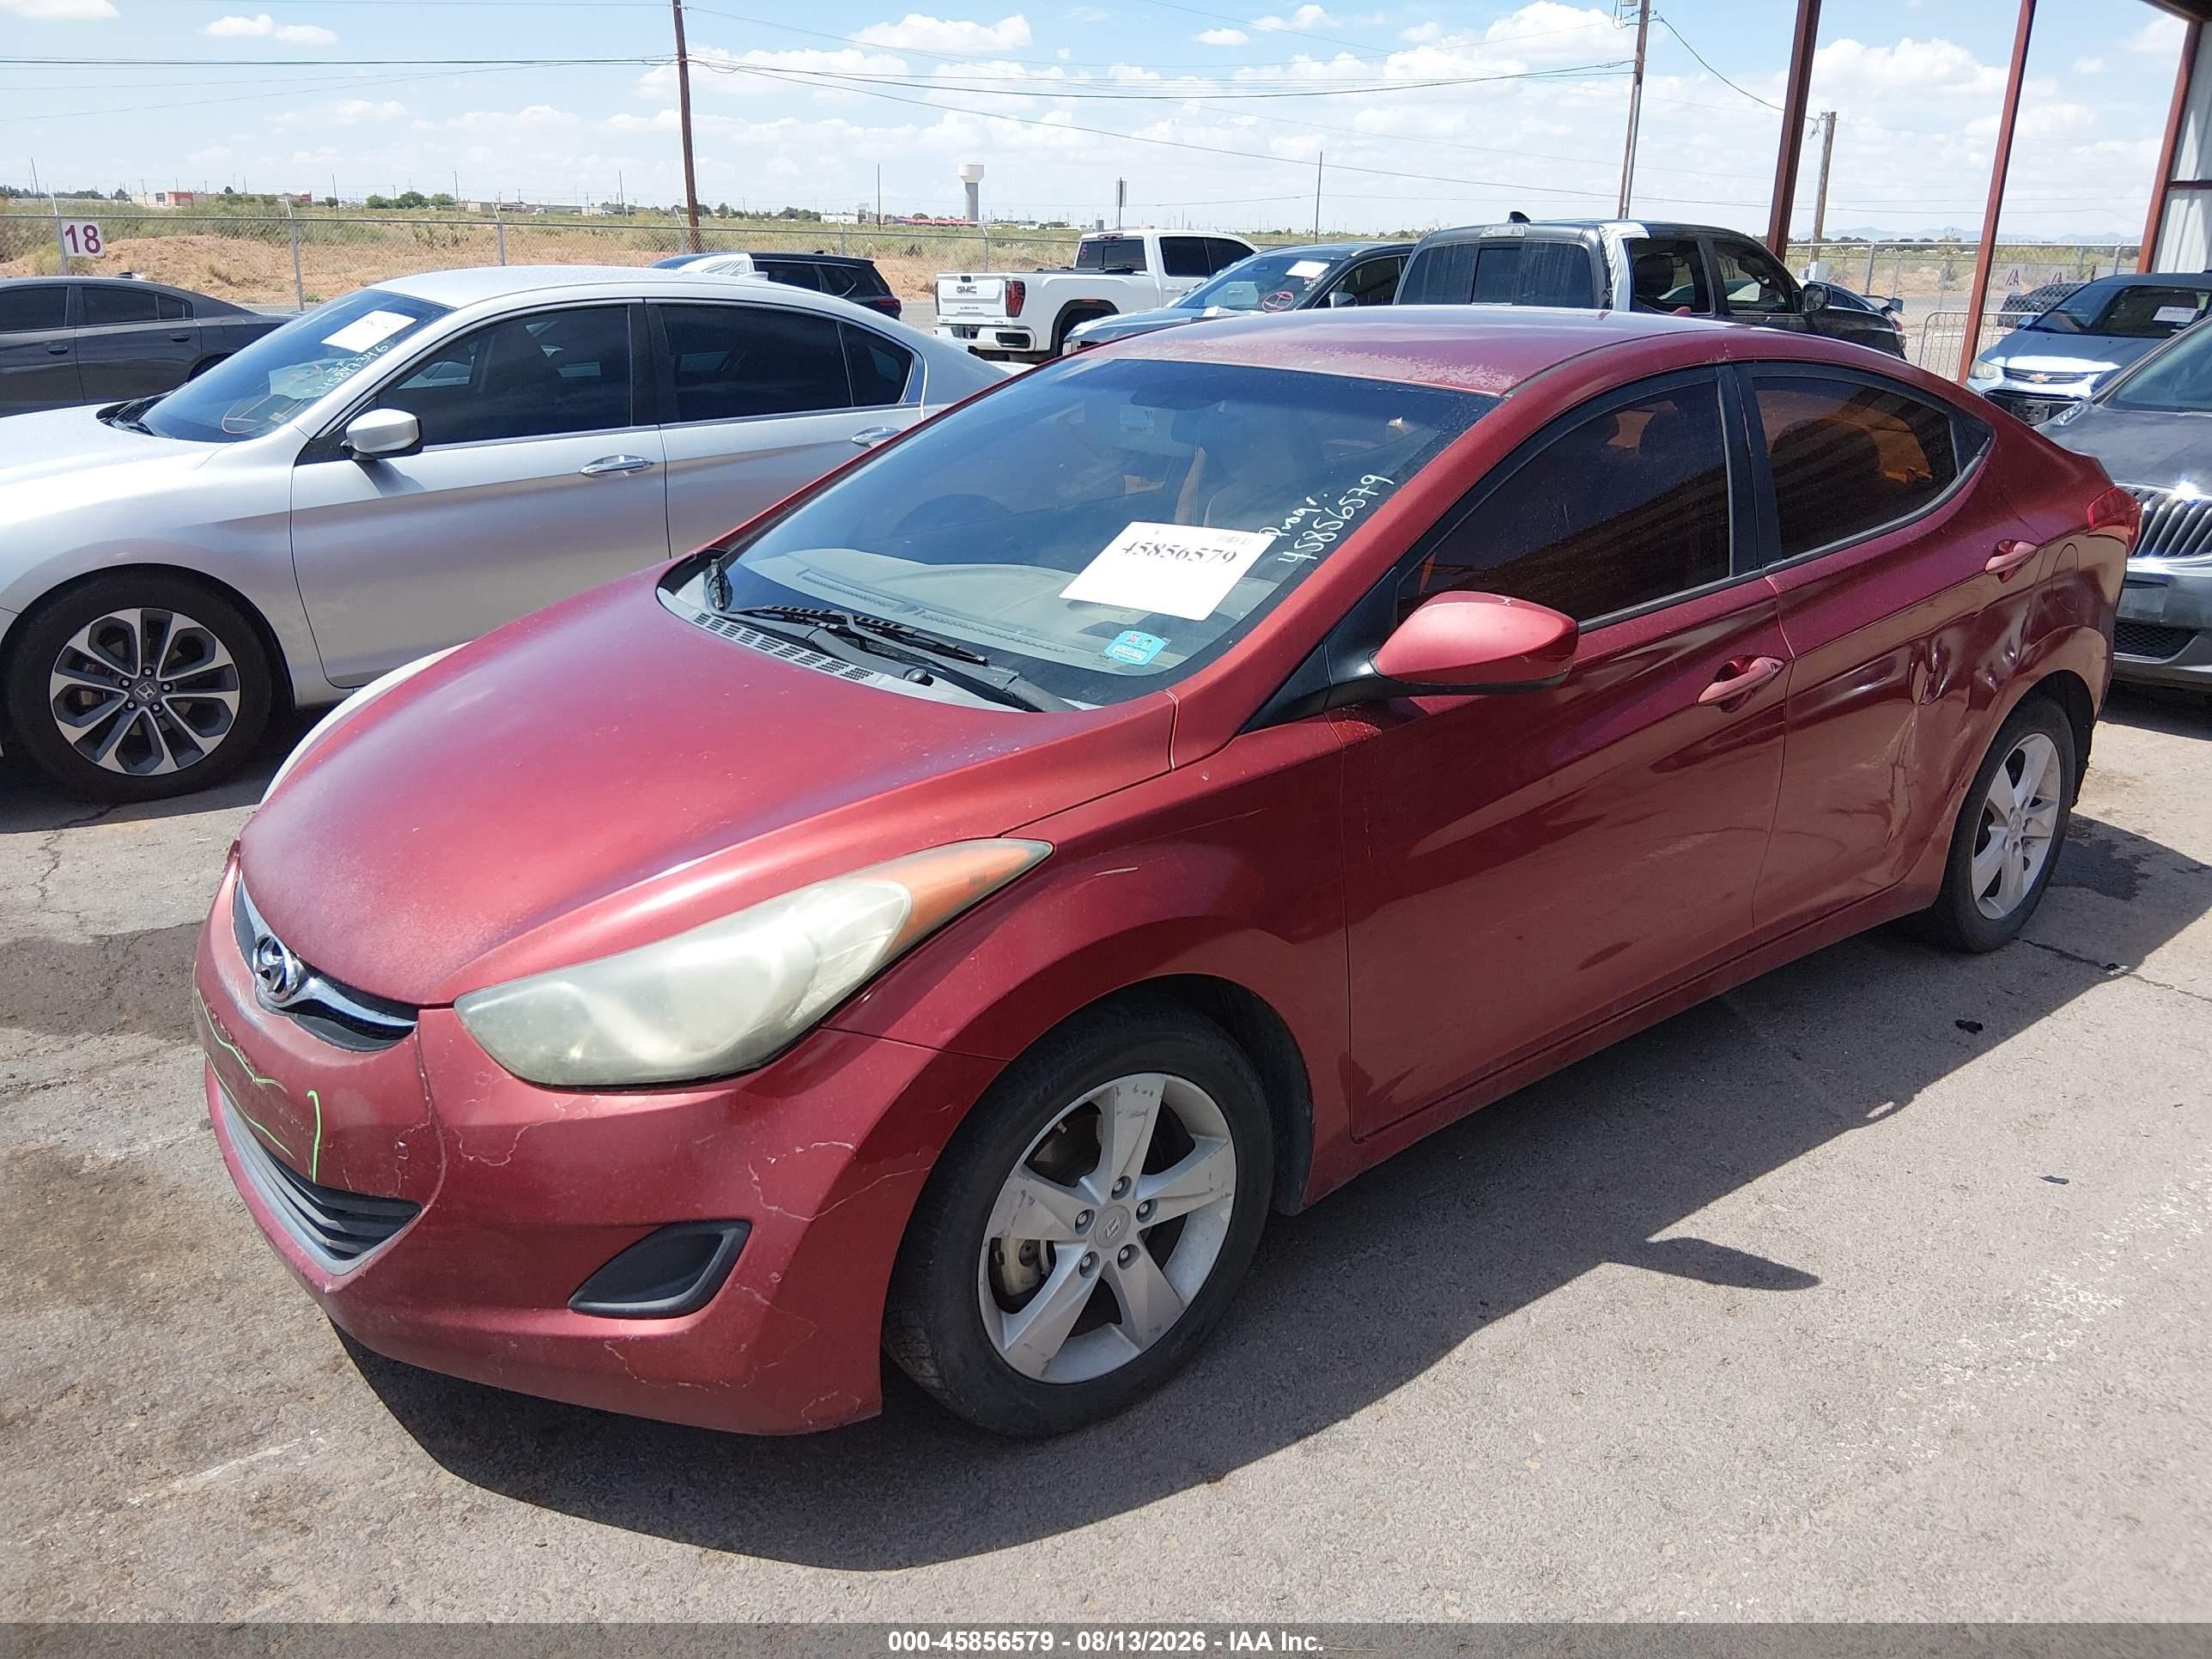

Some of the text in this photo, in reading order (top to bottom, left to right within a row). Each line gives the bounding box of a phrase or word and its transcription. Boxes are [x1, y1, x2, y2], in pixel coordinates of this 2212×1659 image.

[64, 224, 101, 253] 18
[956, 286, 977, 295] GMC
[1277, 474, 1395, 563] 45856579
[1121, 541, 1238, 564] 45856579
